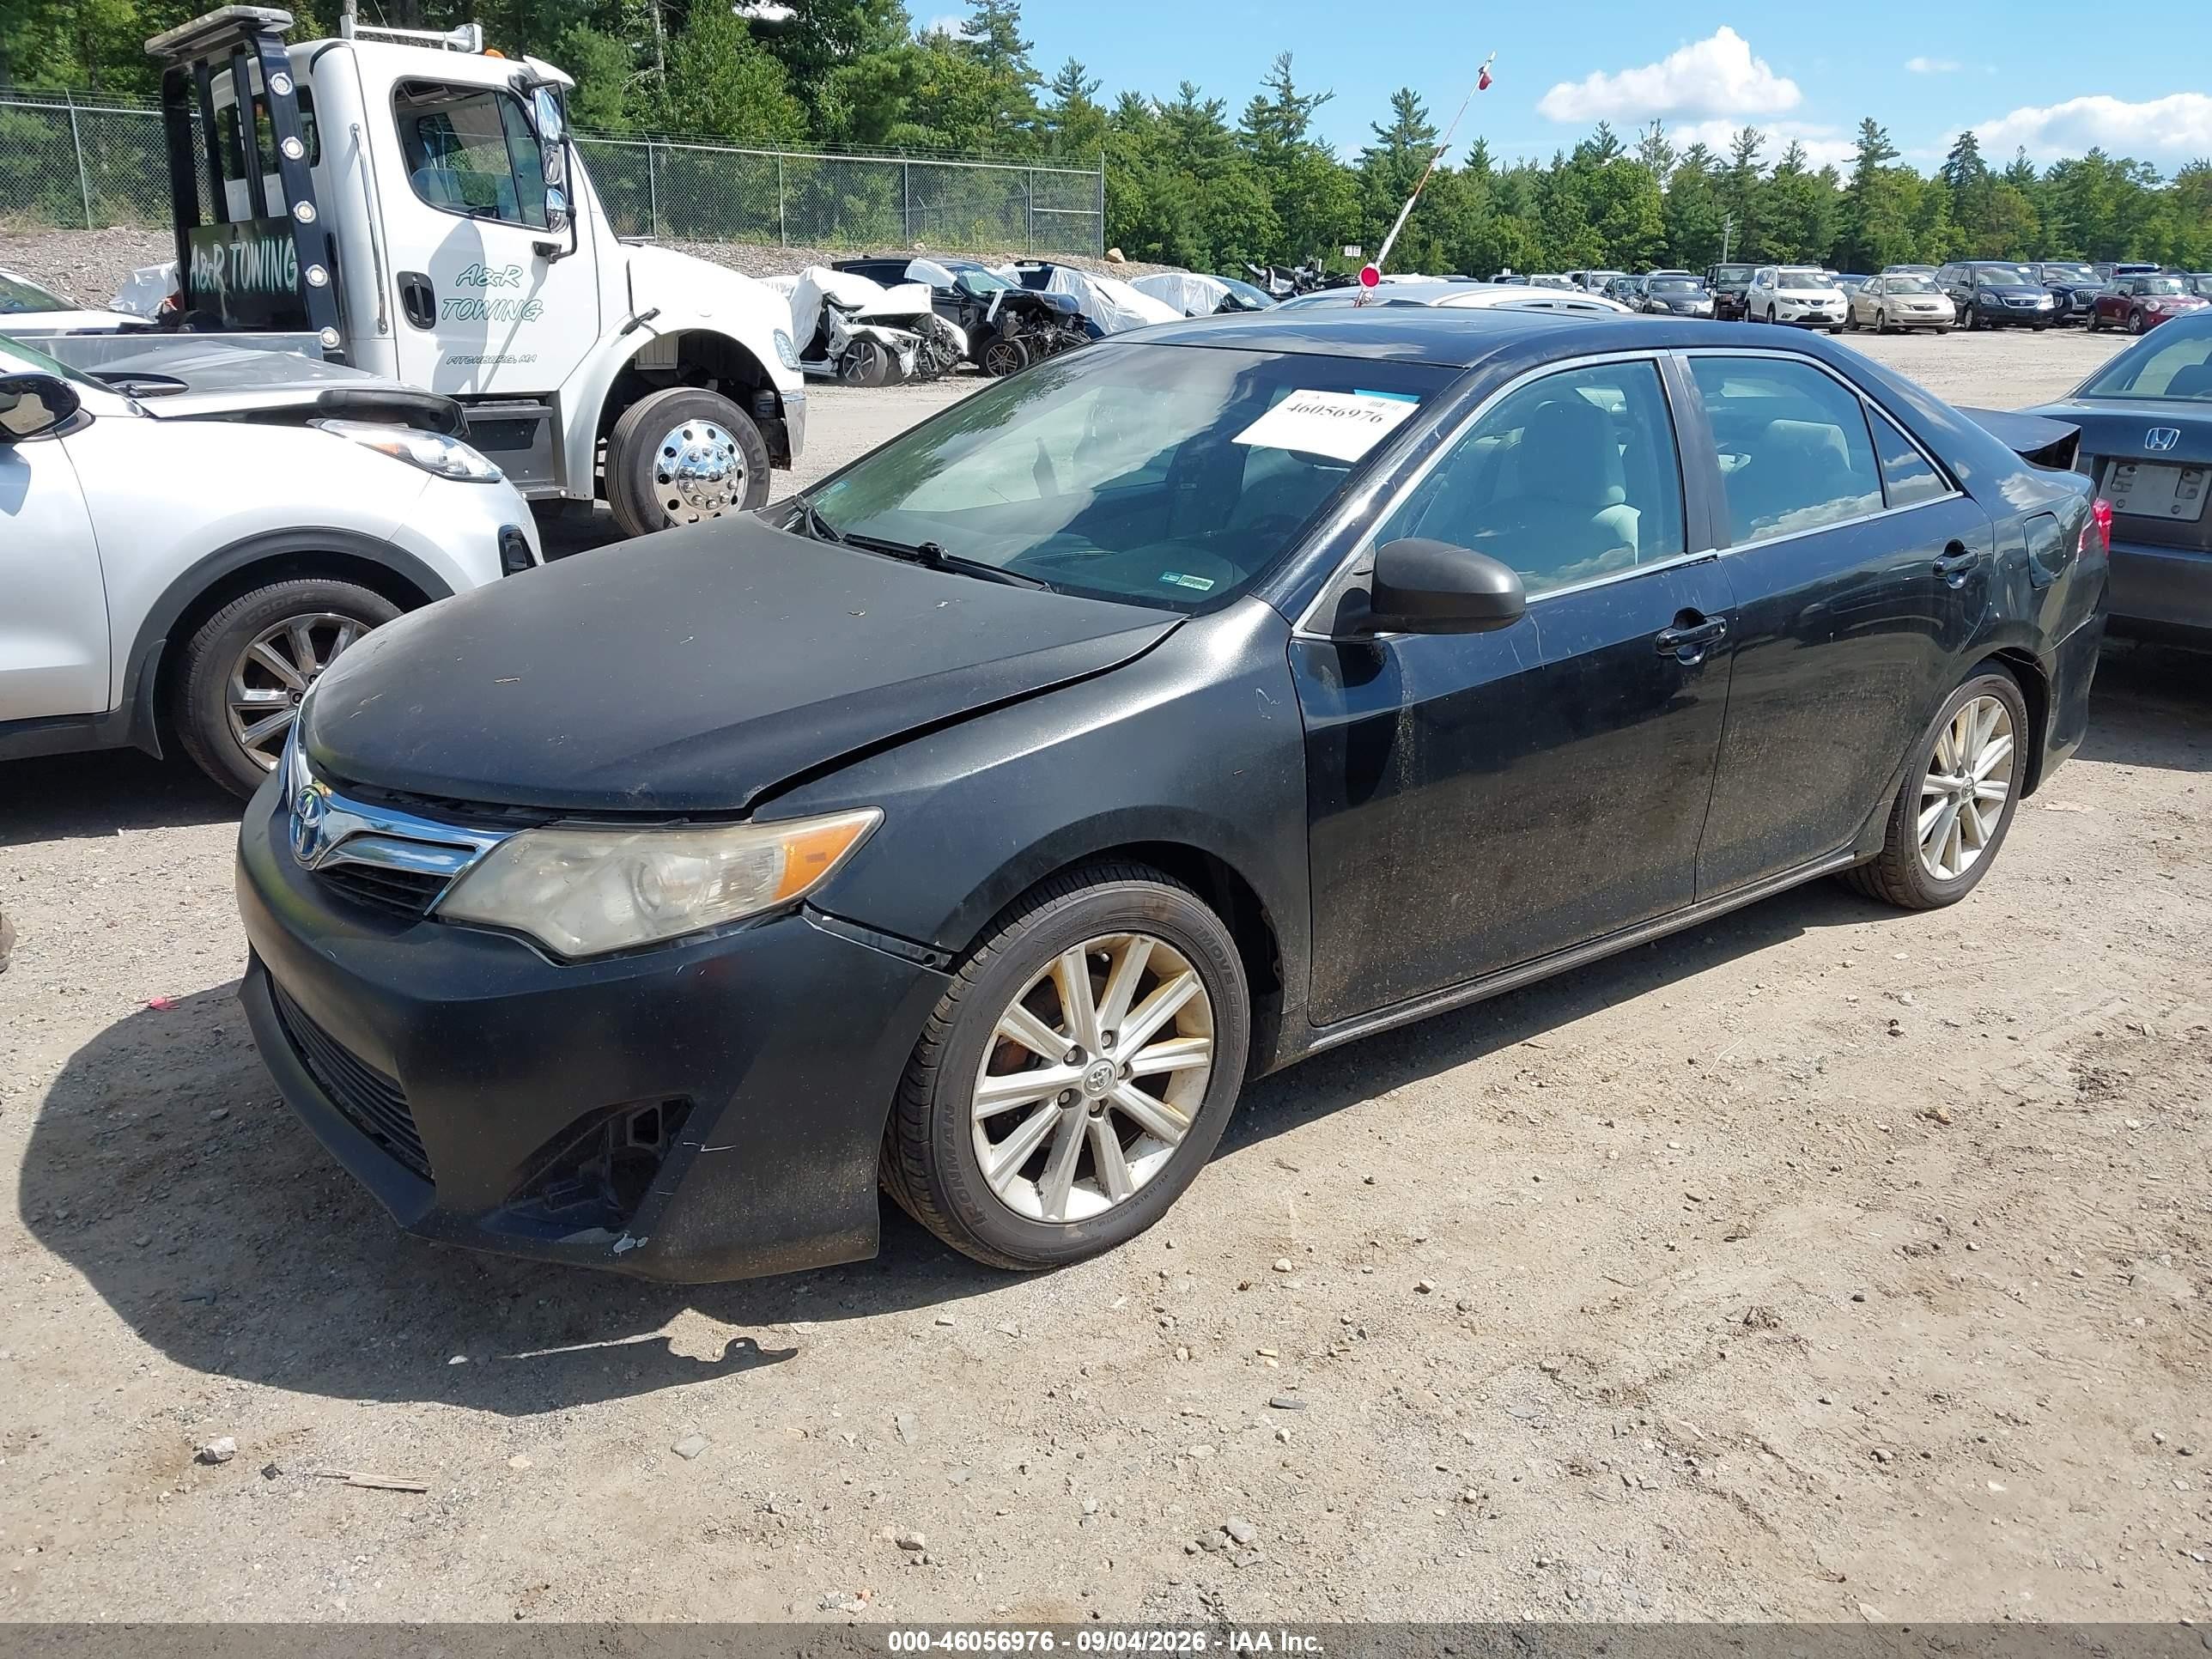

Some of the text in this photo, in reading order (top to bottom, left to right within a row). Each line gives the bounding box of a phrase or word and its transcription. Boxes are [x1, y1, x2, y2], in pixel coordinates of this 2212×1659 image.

[189, 236, 299, 295] A&R TOWING
[455, 263, 524, 289] A&R
[441, 297, 544, 322] TOWING
[1286, 401, 1383, 424] 46056976
[943, 1103, 988, 1227] IRONMAN
